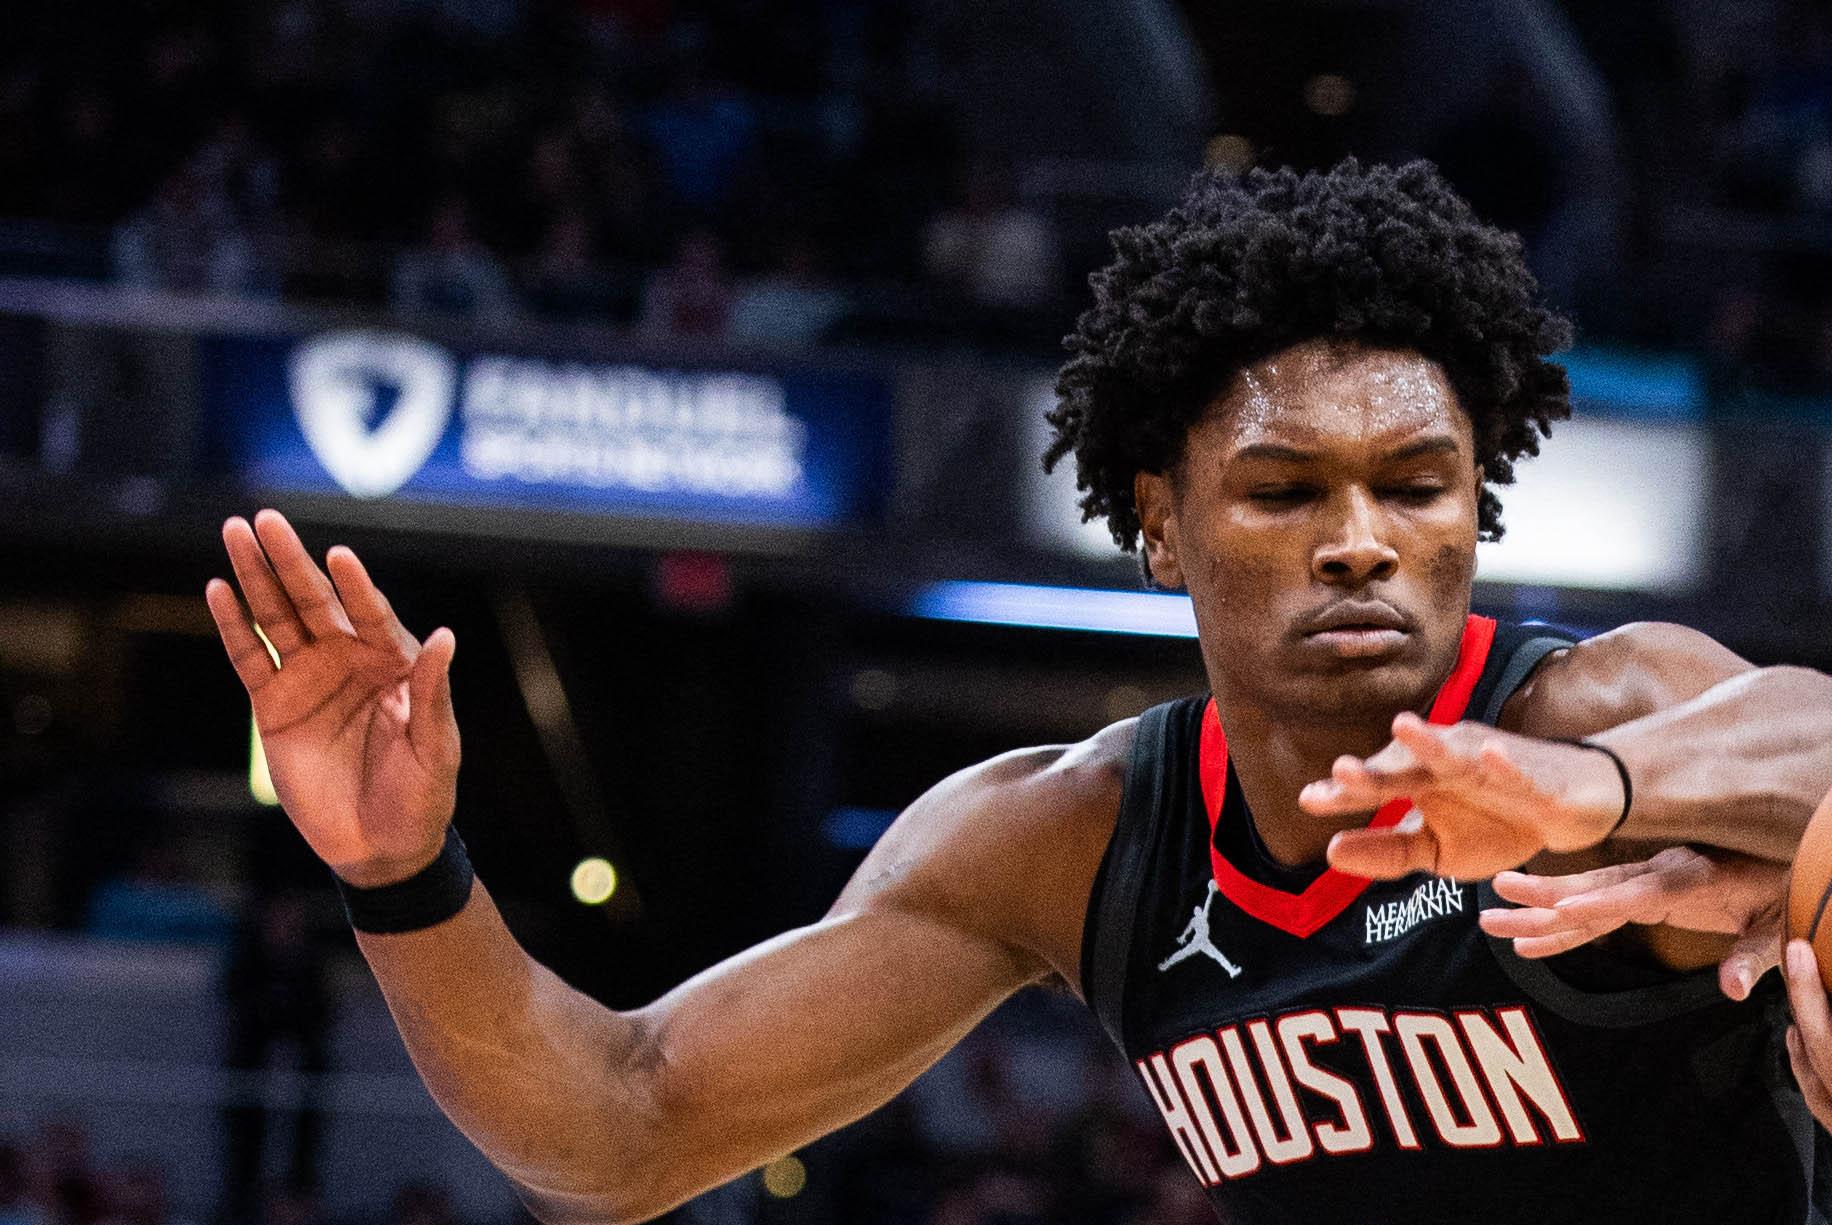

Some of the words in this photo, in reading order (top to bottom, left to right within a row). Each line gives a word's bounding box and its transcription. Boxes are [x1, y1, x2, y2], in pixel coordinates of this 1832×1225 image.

[1365, 892, 1464, 944] HERMANN
[1366, 876, 1464, 925] MEMORIAL
[1135, 1004, 1588, 1188] HOUSTON
